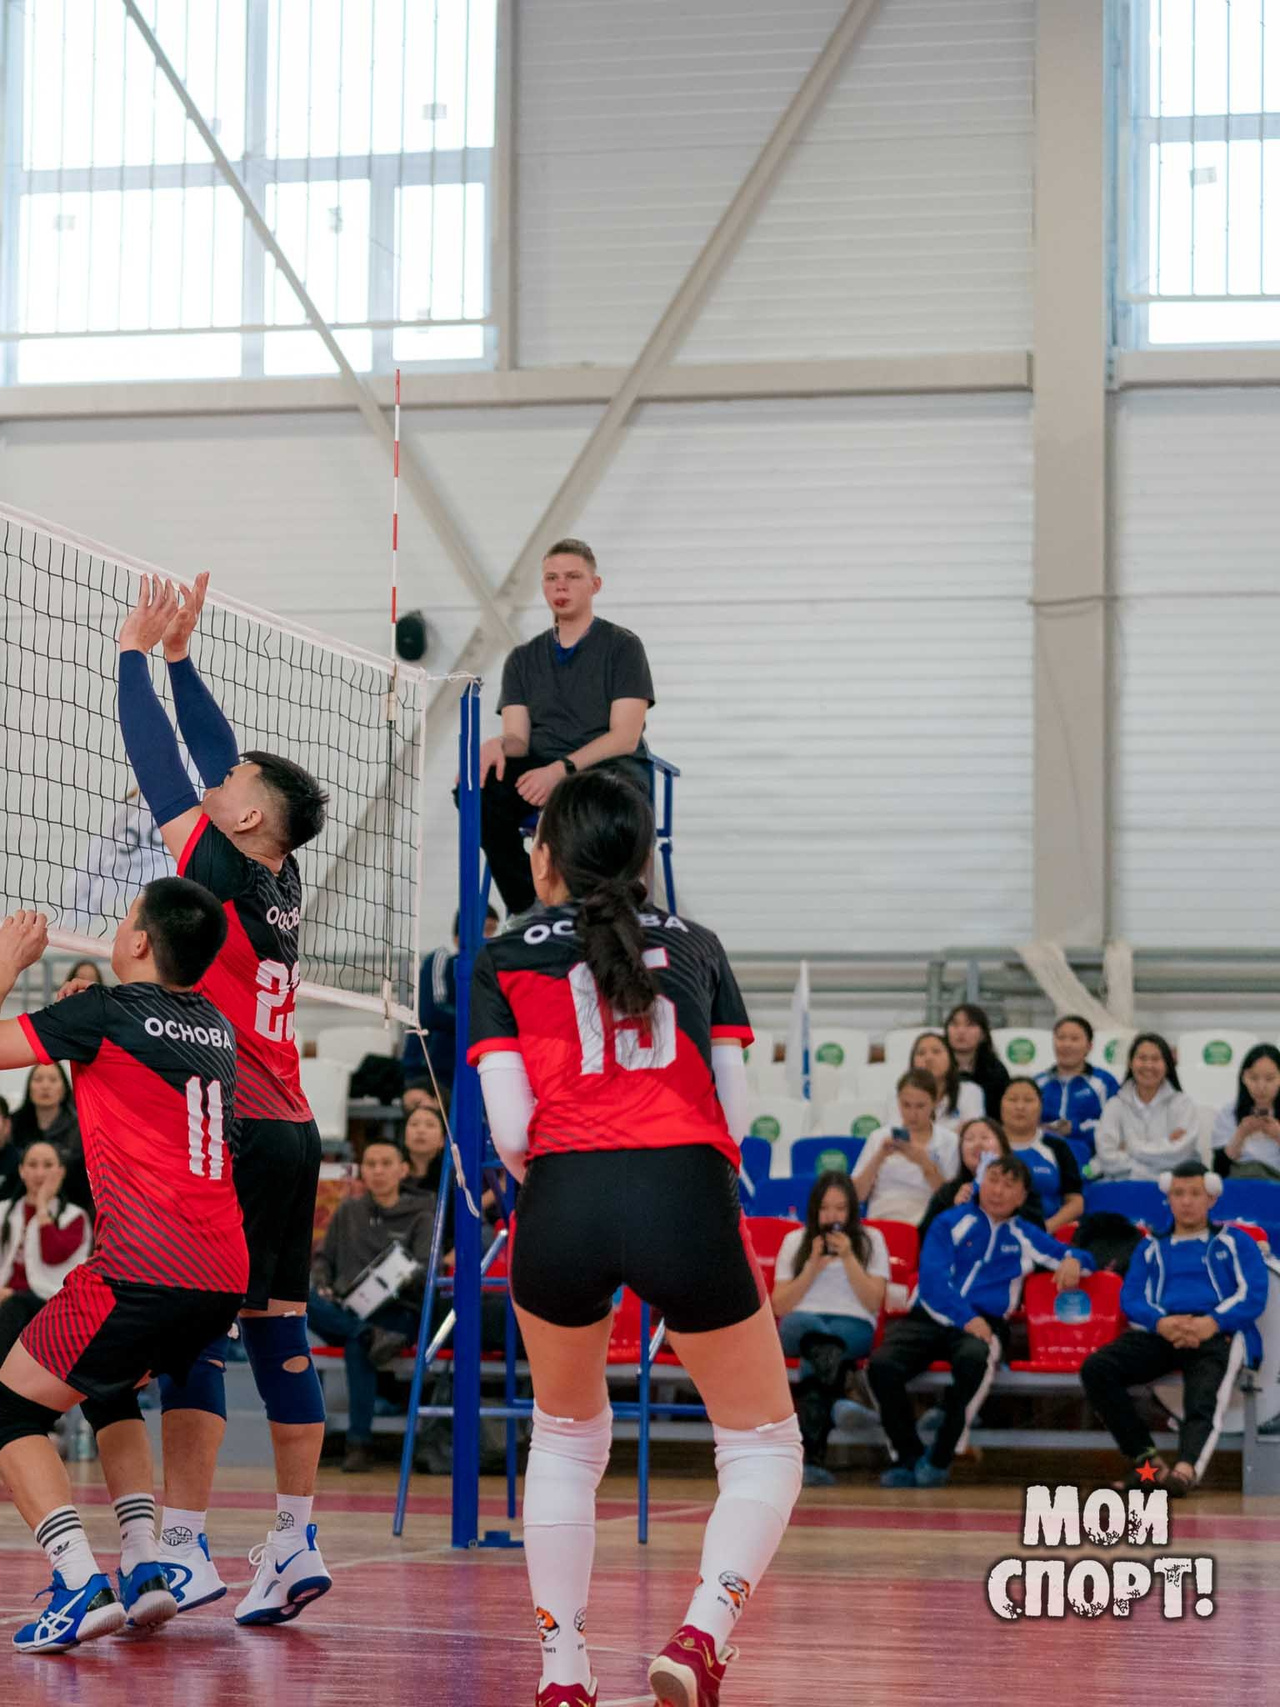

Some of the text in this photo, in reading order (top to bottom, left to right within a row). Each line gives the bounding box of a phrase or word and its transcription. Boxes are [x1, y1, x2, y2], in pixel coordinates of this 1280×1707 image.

[523, 913, 689, 945] ОСВА
[144, 1017, 233, 1051] ОСНОВА
[567, 947, 677, 1075] 15
[185, 1076, 225, 1180] 11
